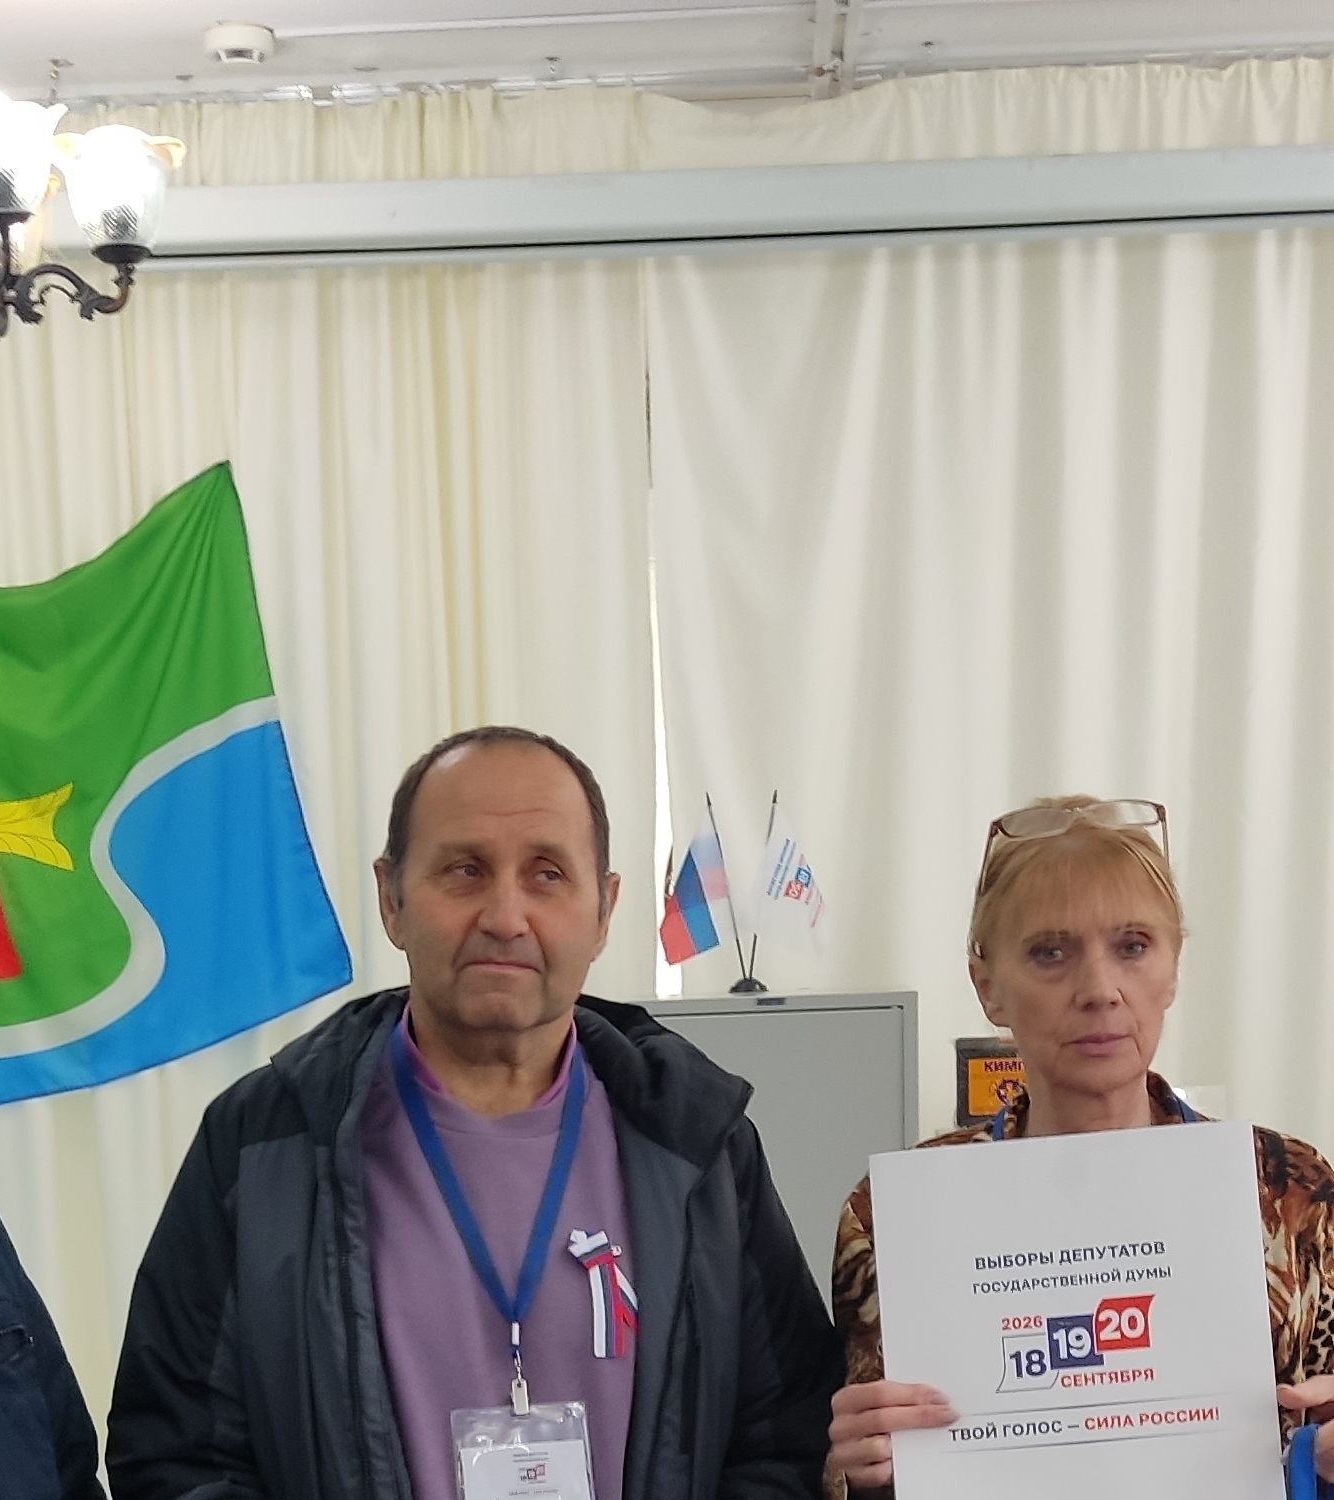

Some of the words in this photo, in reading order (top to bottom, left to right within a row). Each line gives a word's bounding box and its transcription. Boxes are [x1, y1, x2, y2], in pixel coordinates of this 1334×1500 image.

[975, 1251, 1055, 1270] ВЫБОРЫ
[1059, 1241, 1166, 1266] ДЕПУТАТОВ
[972, 1267, 1122, 1295] ГОСУДАРСТВЕННОЙ
[1125, 1265, 1172, 1284] ДУМЫ
[1001, 1315, 1044, 1331] 2026
[1009, 1349, 1048, 1378] 18
[1052, 1326, 1092, 1360] 19
[1098, 1306, 1146, 1342] 20
[1060, 1367, 1155, 1388] СЕНТЯБРЯ
[948, 1421, 998, 1442] ТВОЙ
[1002, 1420, 1064, 1438] ГОЛОС
[1083, 1414, 1135, 1431] СИЛА
[1138, 1406, 1221, 1426] РОССИИ!
